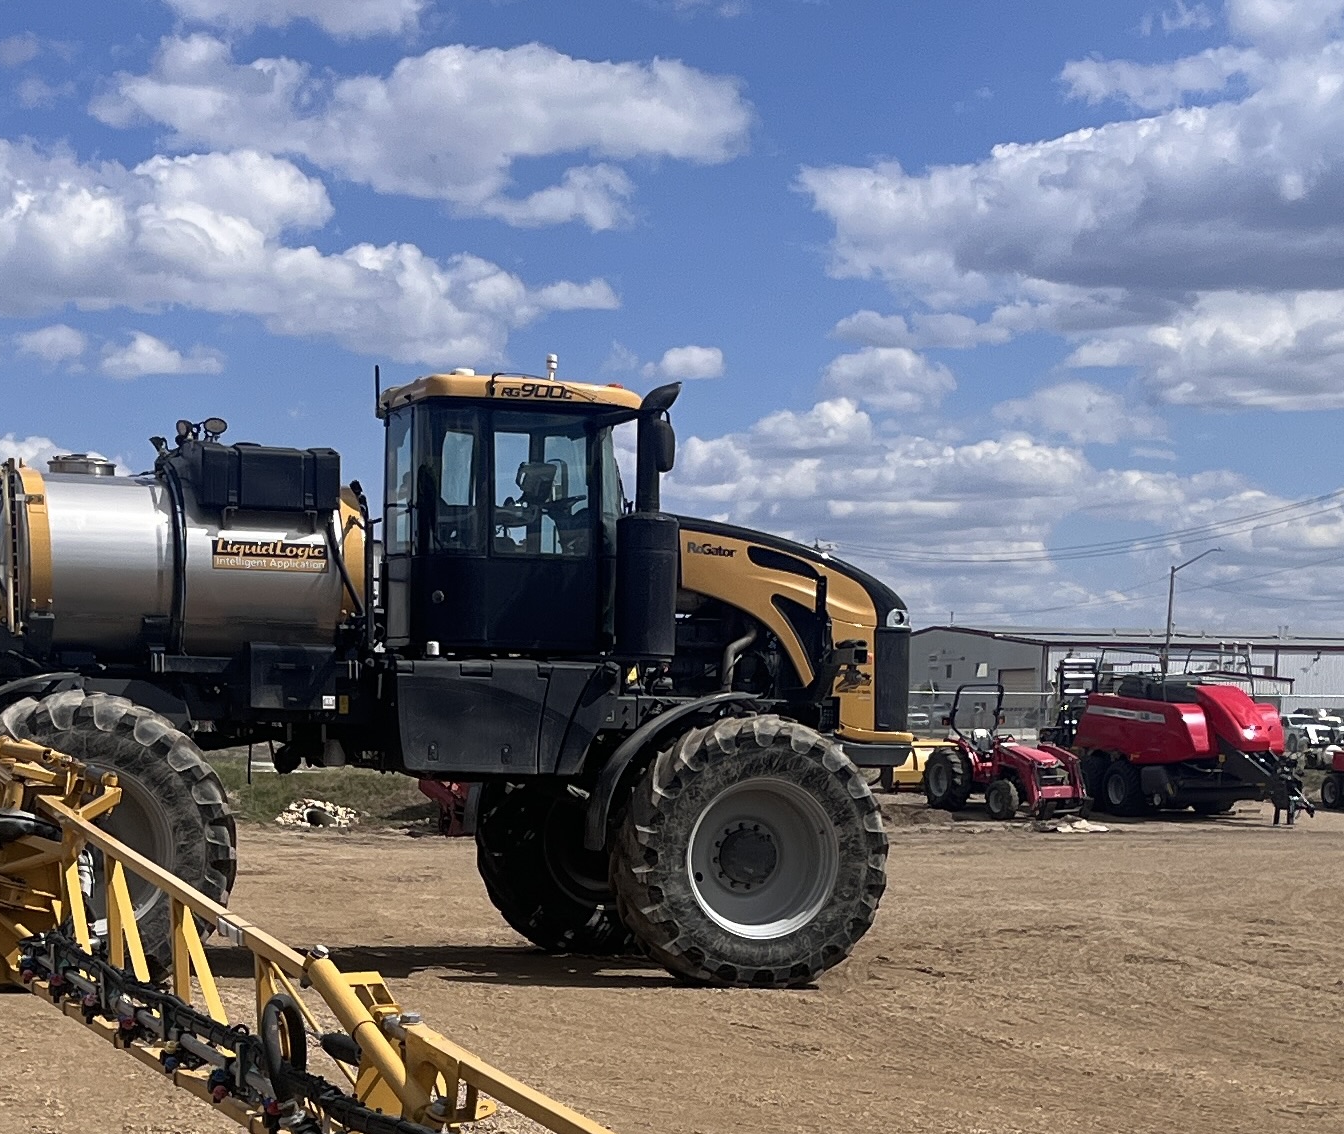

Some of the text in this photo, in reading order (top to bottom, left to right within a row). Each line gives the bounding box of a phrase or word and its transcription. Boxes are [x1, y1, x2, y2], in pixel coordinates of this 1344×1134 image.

[687, 541, 737, 557] RoGator
[216, 557, 326, 569] Intelligent Application
